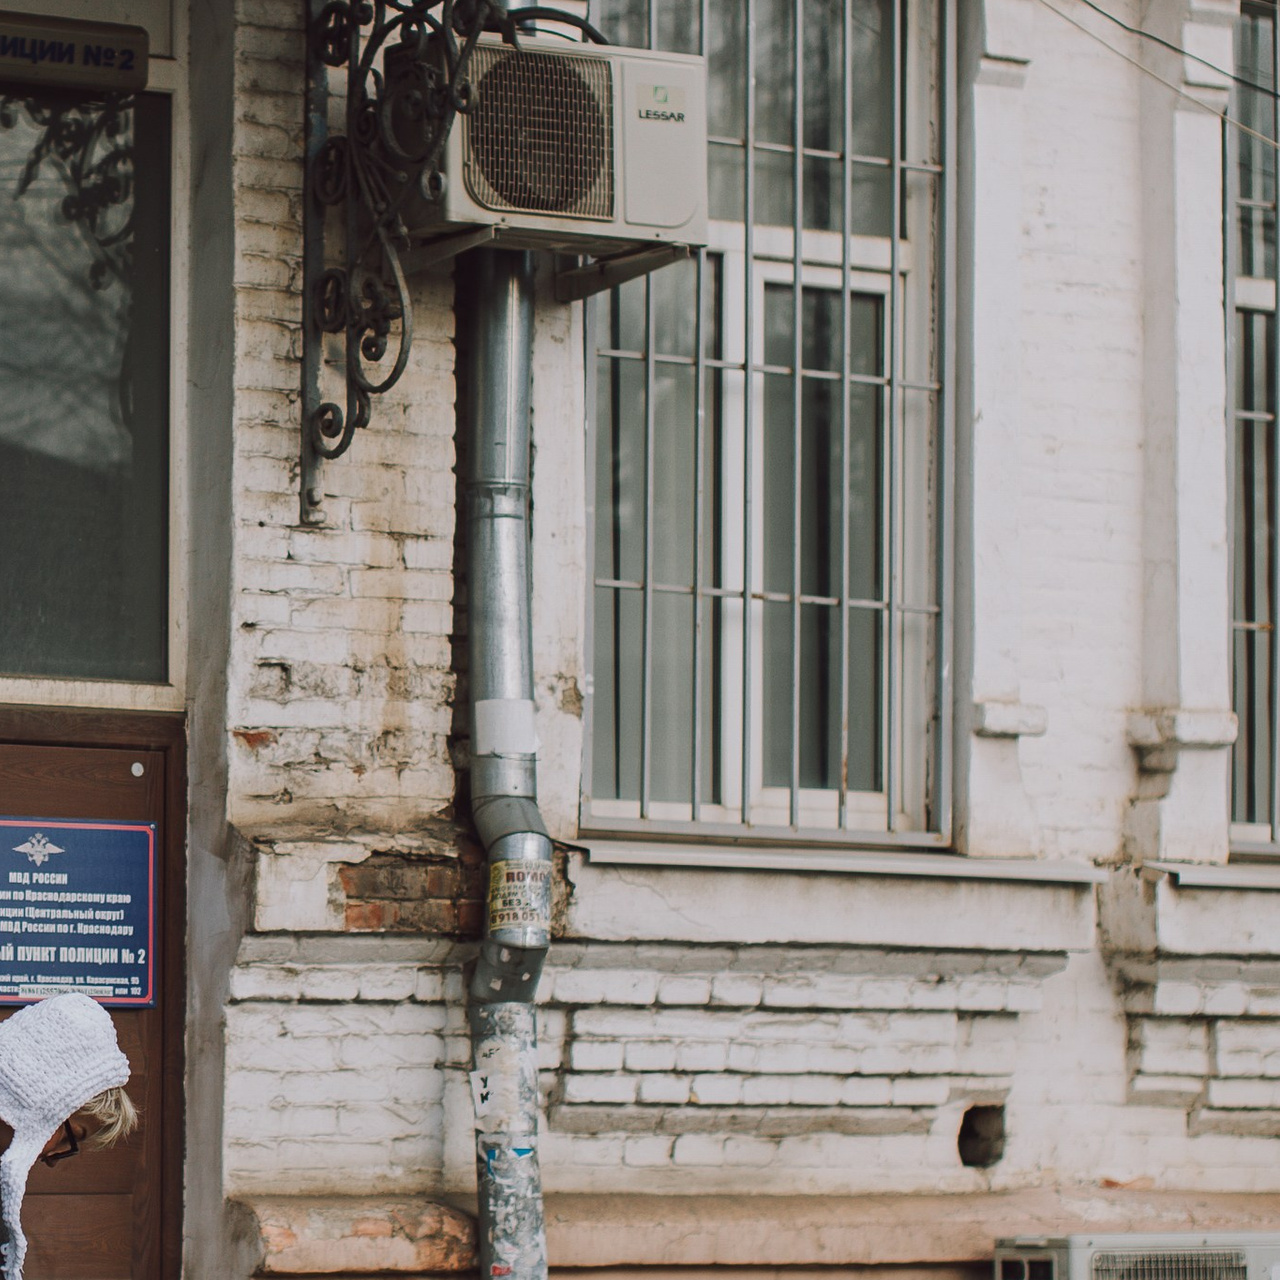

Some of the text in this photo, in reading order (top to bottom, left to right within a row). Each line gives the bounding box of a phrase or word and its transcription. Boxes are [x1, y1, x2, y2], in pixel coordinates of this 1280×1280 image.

[638, 109, 685, 122] LESSAR
[8, 872, 68, 885] МВД РОССИИ
[12, 891, 24, 901] по
[25, 890, 105, 904] Краснодарскому
[106, 893, 132, 904] краю
[25, 906, 94, 920] (Центральный
[95, 909, 125, 921] округ)
[0, 920, 22, 934] МВД
[22, 921, 56, 934] России
[57, 923, 69, 934] по
[70, 924, 76, 934] г.
[77, 923, 134, 936] Краснодару
[17, 946, 56, 962] ПУНКТ
[60, 947, 118, 965] ПОЛИЦИИ
[121, 949, 135, 964] №
[138, 949, 146, 964] 2
